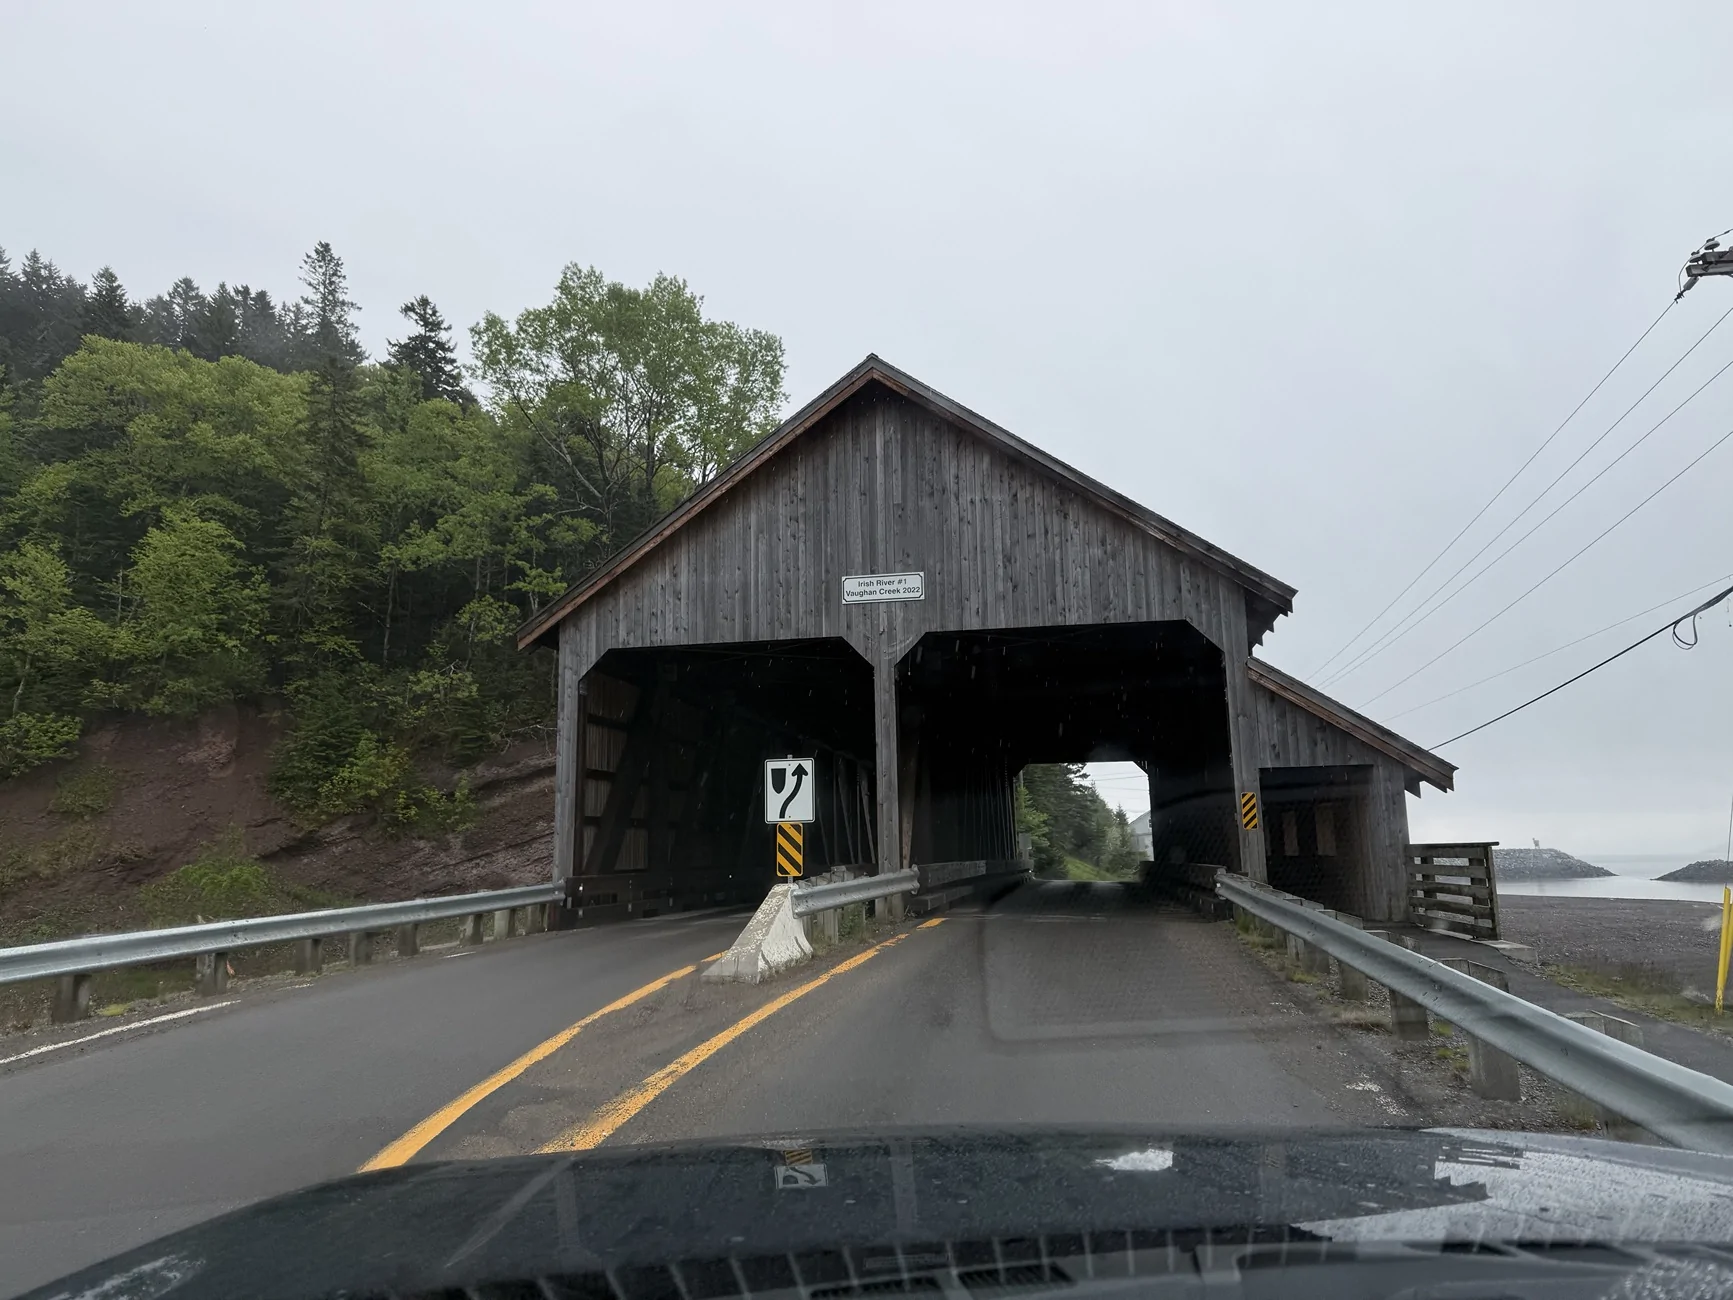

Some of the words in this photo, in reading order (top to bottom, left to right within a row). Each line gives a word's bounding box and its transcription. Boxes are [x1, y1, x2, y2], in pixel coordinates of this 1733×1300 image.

[858, 580, 875, 588] Irish
[876, 579, 895, 587] River
[846, 589, 877, 597] Vaughan
[902, 586, 921, 594] 2022
